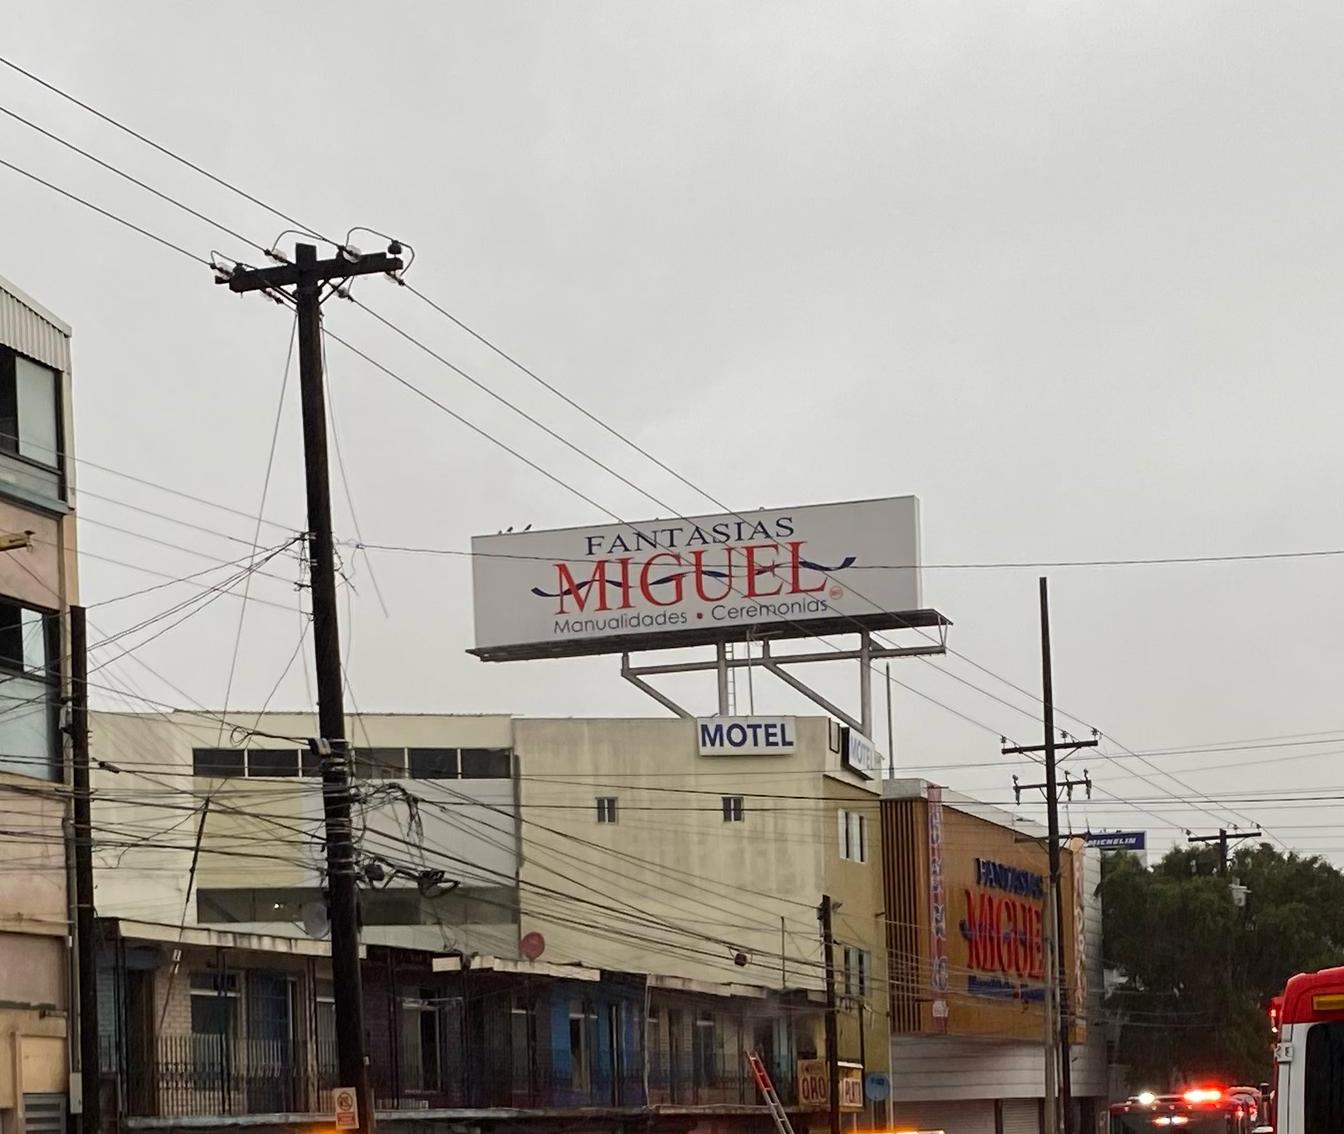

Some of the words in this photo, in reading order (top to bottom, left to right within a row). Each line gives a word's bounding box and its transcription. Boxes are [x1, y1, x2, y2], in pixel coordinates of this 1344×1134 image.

[585, 516, 795, 556] FANTASIAS
[554, 540, 828, 615] MIGUEL
[553, 609, 689, 634] Manualidades
[711, 597, 829, 622] Ceremonias
[700, 723, 794, 748] MOTEL
[1088, 837, 1137, 846] MICHELIN
